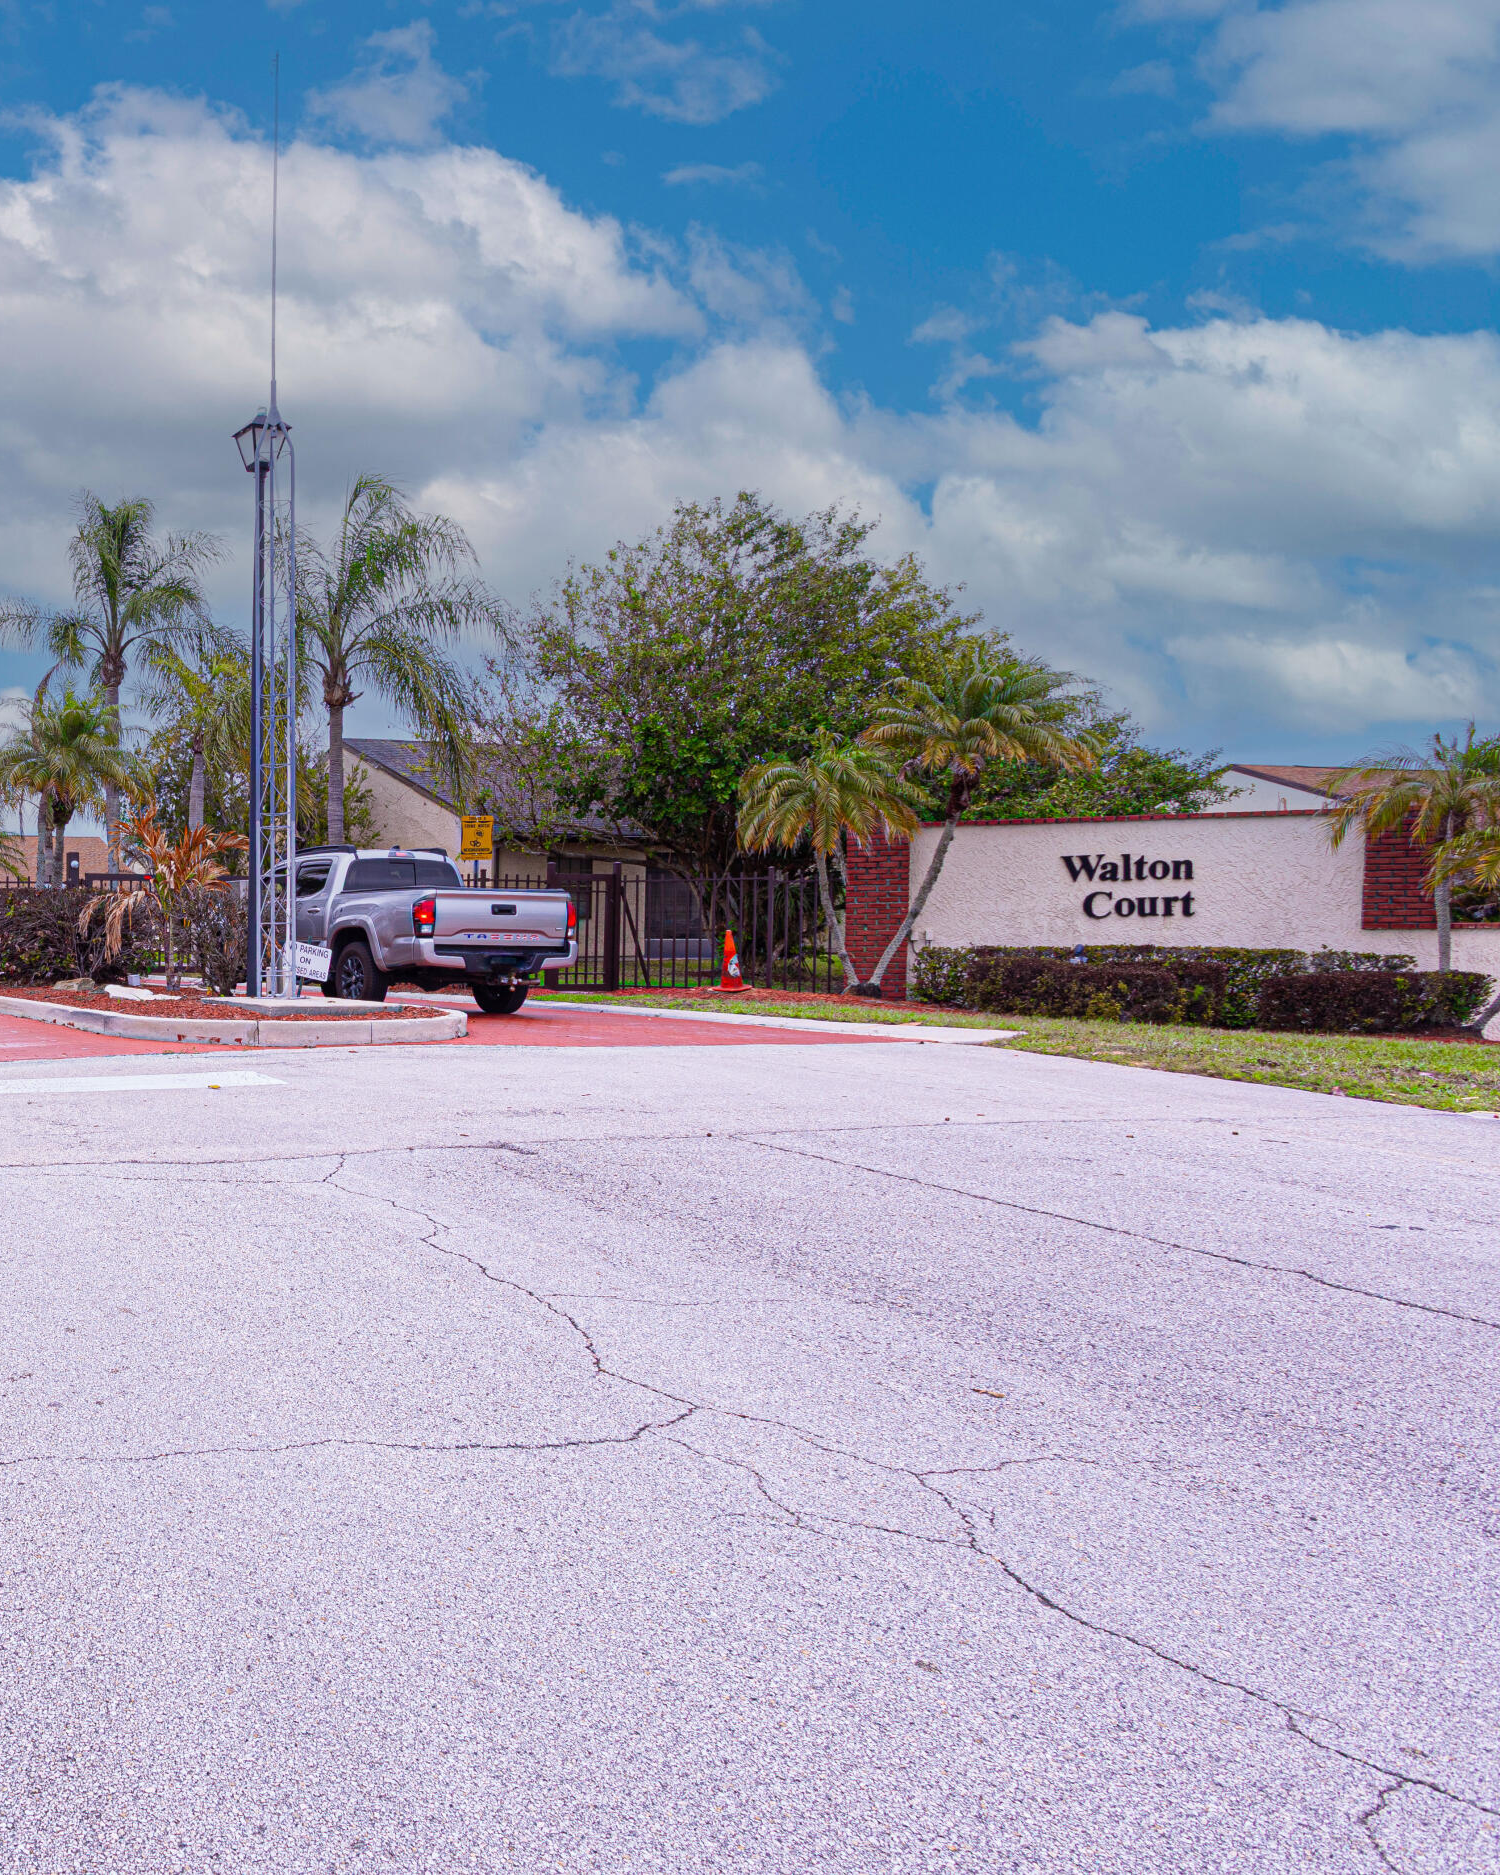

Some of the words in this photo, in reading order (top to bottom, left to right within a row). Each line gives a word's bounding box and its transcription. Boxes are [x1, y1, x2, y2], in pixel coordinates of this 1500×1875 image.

[1060, 854, 1194, 882] Walton
[1083, 891, 1195, 920] Court
[300, 944, 329, 959] PARKING
[300, 956, 311, 965] ON
[309, 969, 327, 979] AREAS
